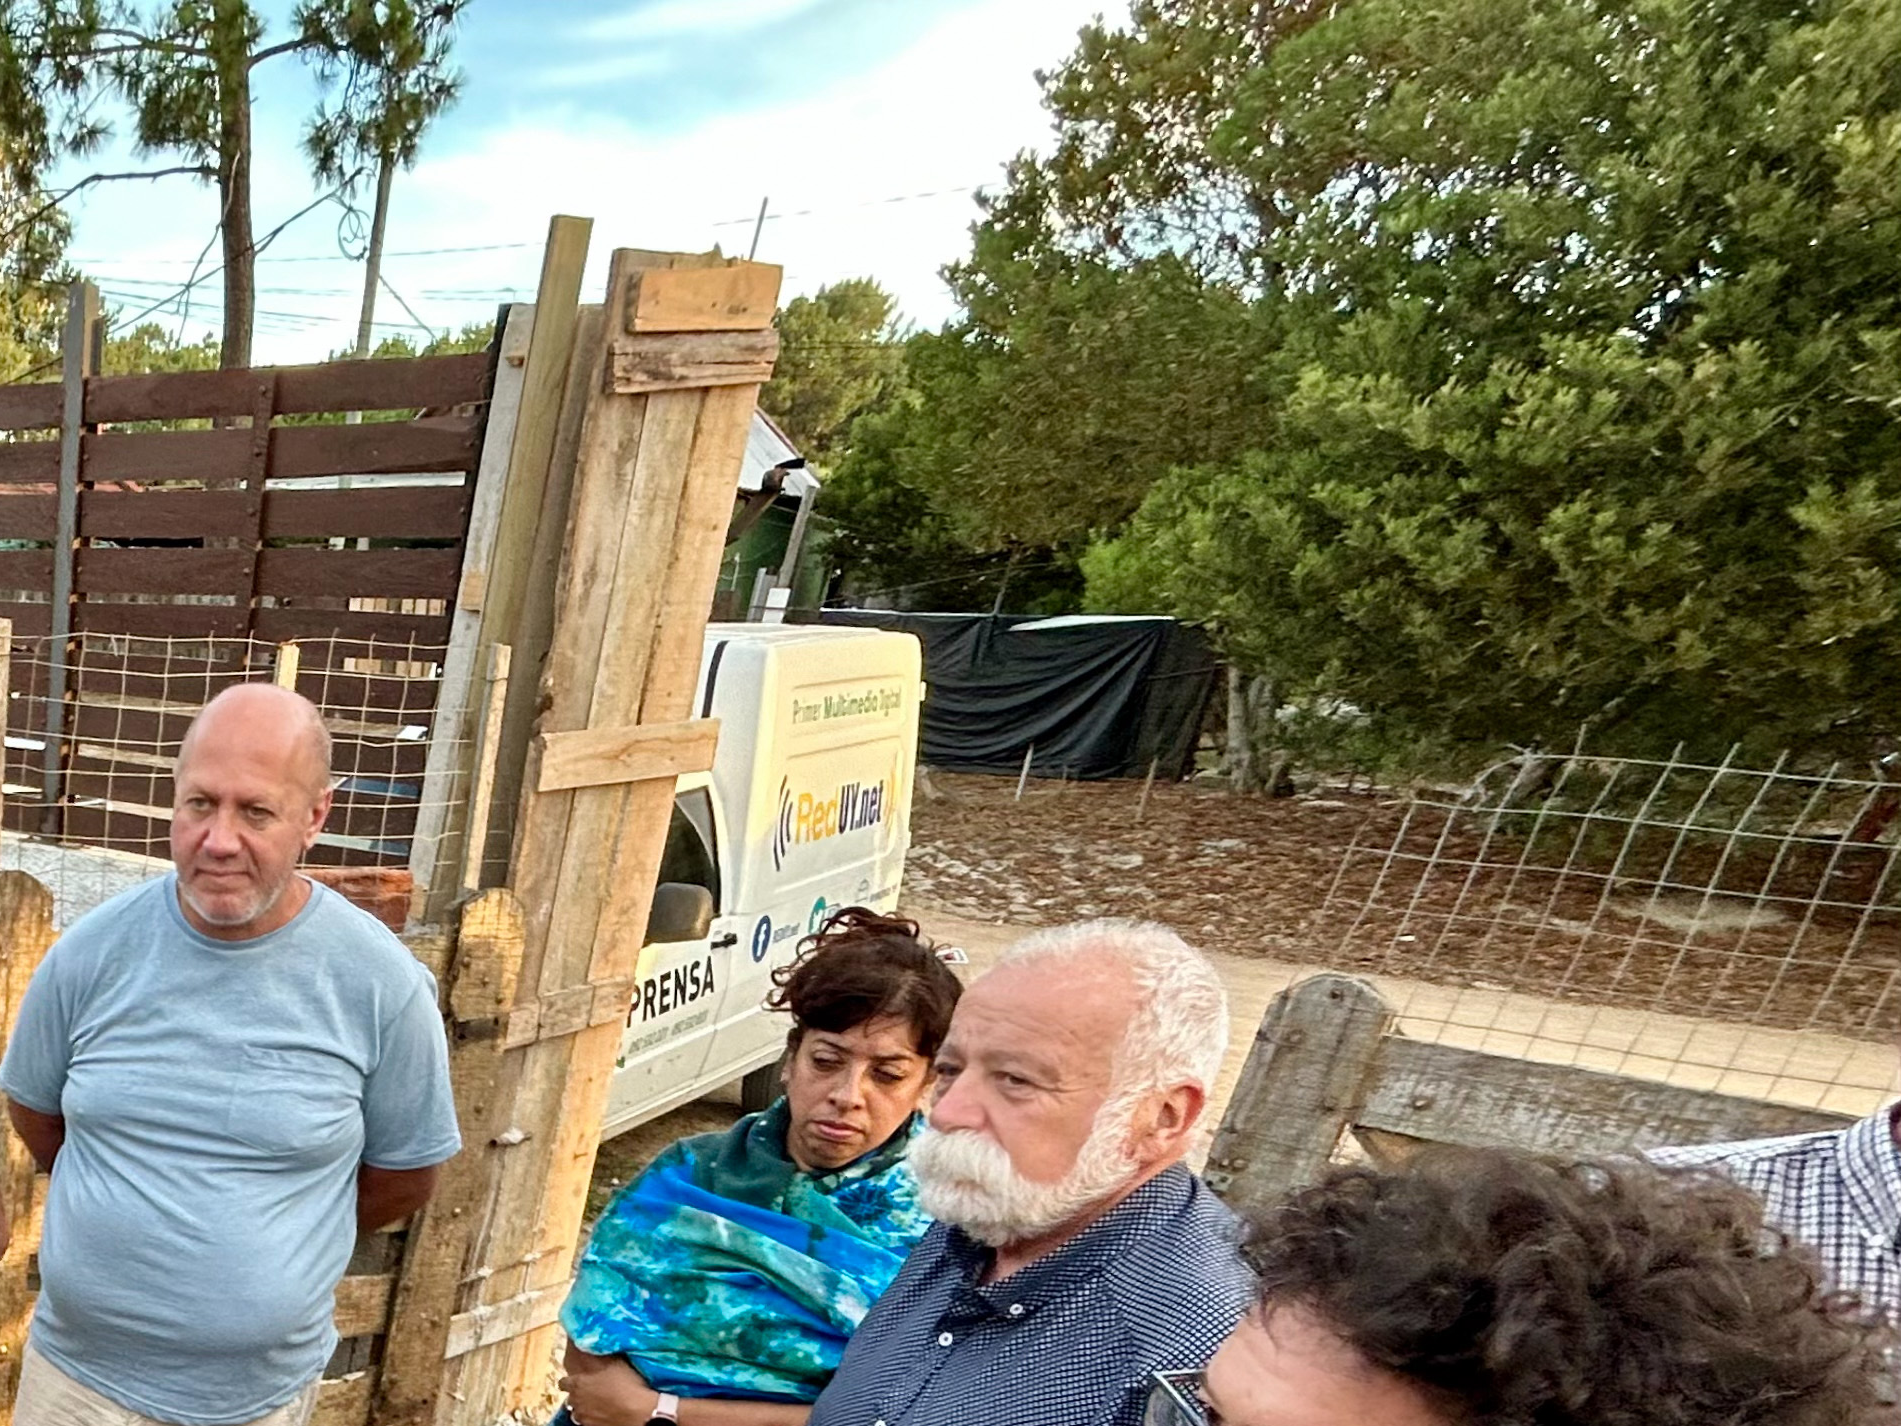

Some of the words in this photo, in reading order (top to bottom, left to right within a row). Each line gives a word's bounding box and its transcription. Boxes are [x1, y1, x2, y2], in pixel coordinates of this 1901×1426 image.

[792, 699, 821, 724] Primer
[823, 690, 878, 719] Multimedio
[626, 956, 714, 1027] PRENSA
